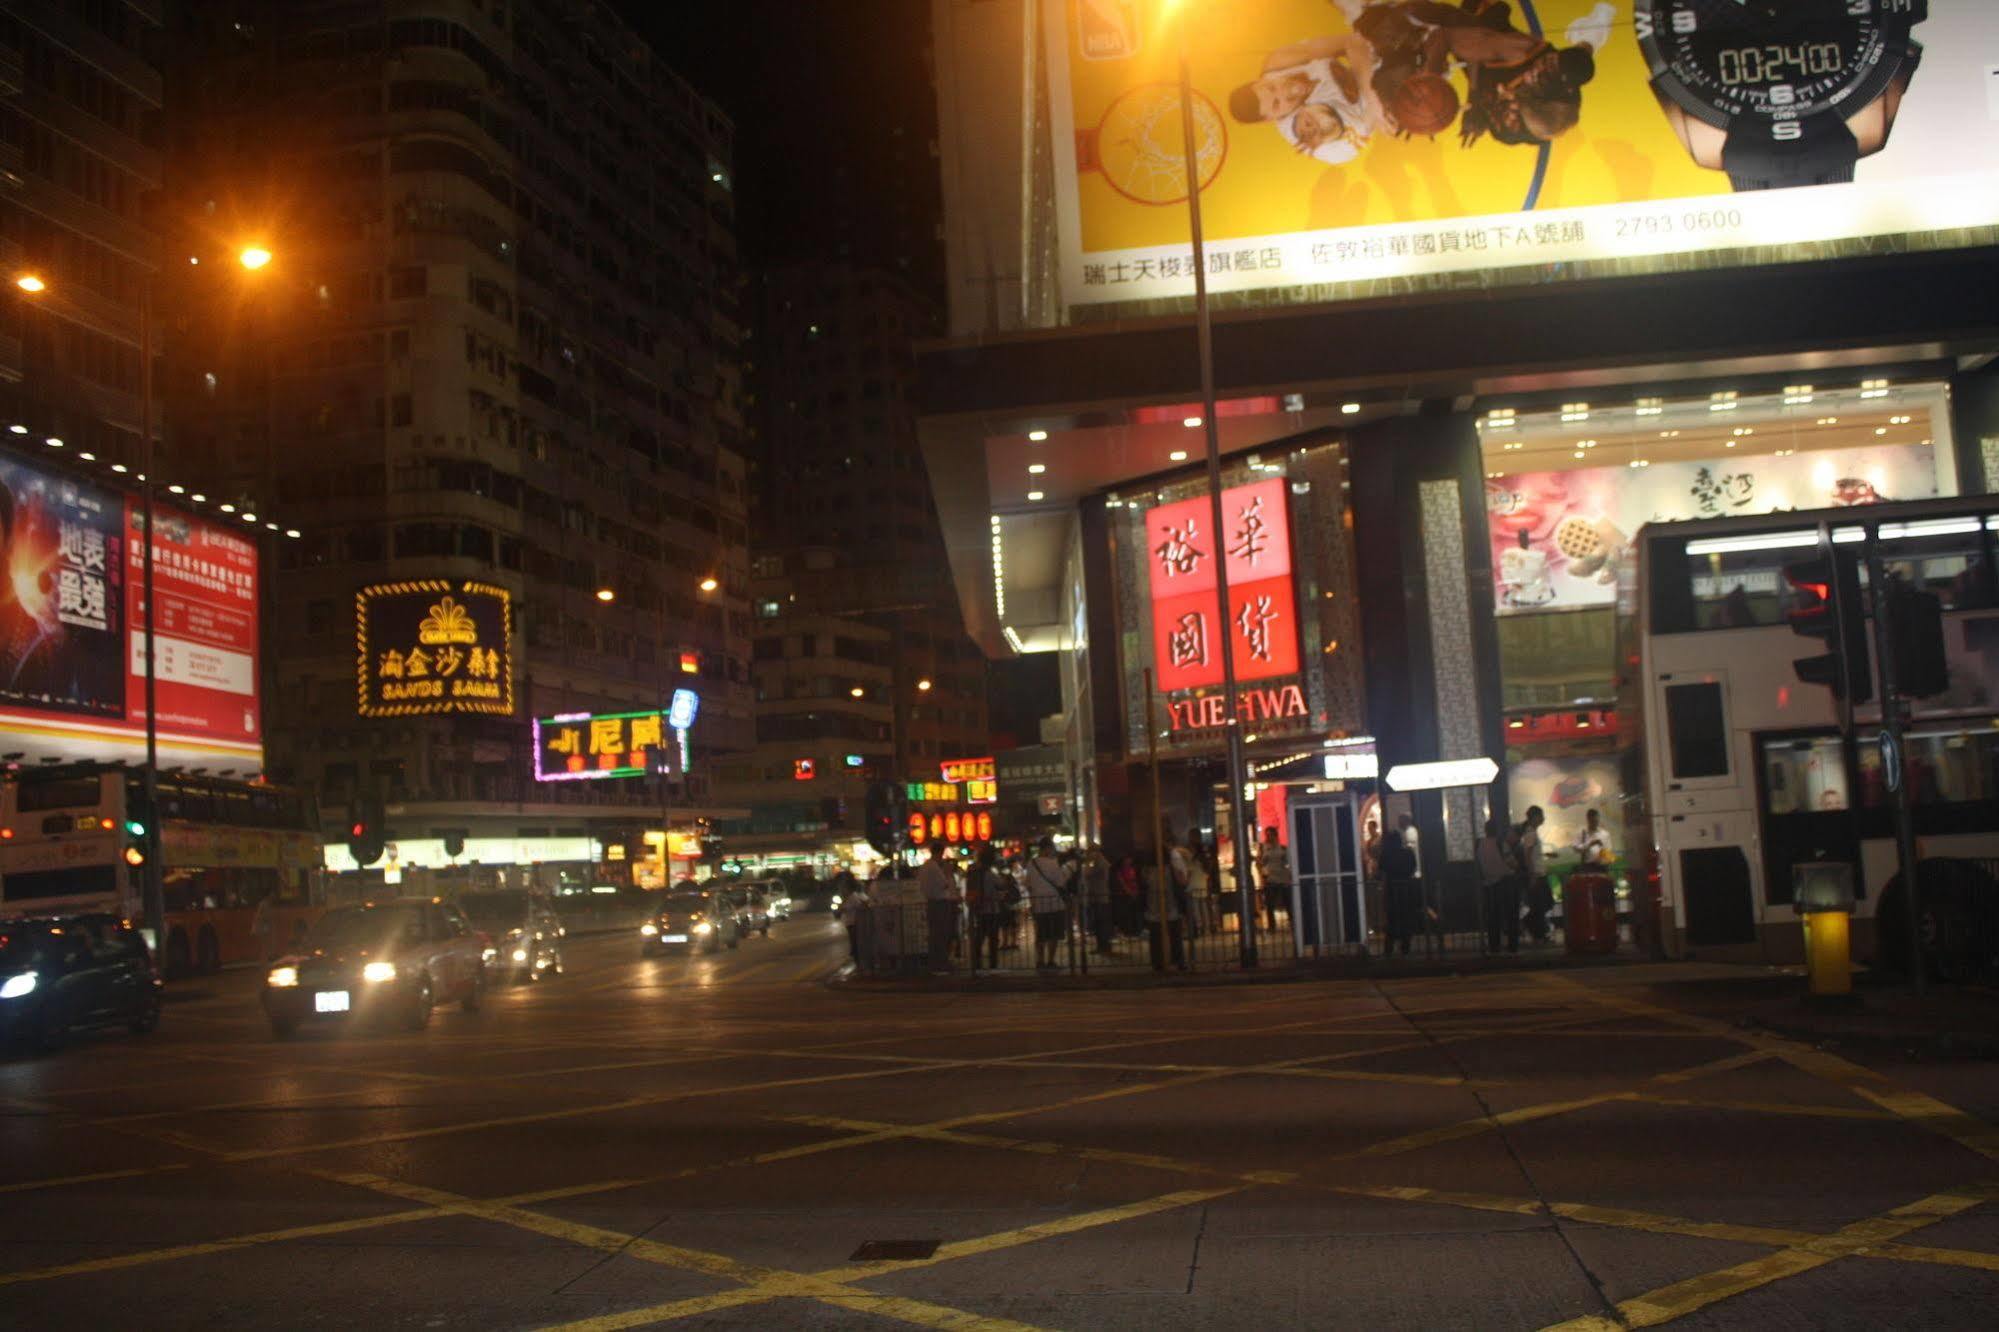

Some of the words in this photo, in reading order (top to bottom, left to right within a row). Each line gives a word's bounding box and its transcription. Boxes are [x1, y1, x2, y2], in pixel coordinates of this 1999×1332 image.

[1634, 11, 1654, 40] W
[1671, 10, 1697, 34] 9
[1769, 84, 1795, 105] 6
[1771, 121, 1802, 141] S
[1616, 214, 1673, 240] 2793
[1682, 209, 1742, 232] 0600
[1154, 496, 1269, 578] 裕華
[1168, 594, 1279, 668] 國貨
[382, 680, 443, 701] SANDS
[1167, 695, 1226, 731] YUE
[1234, 686, 1309, 723] HWA
